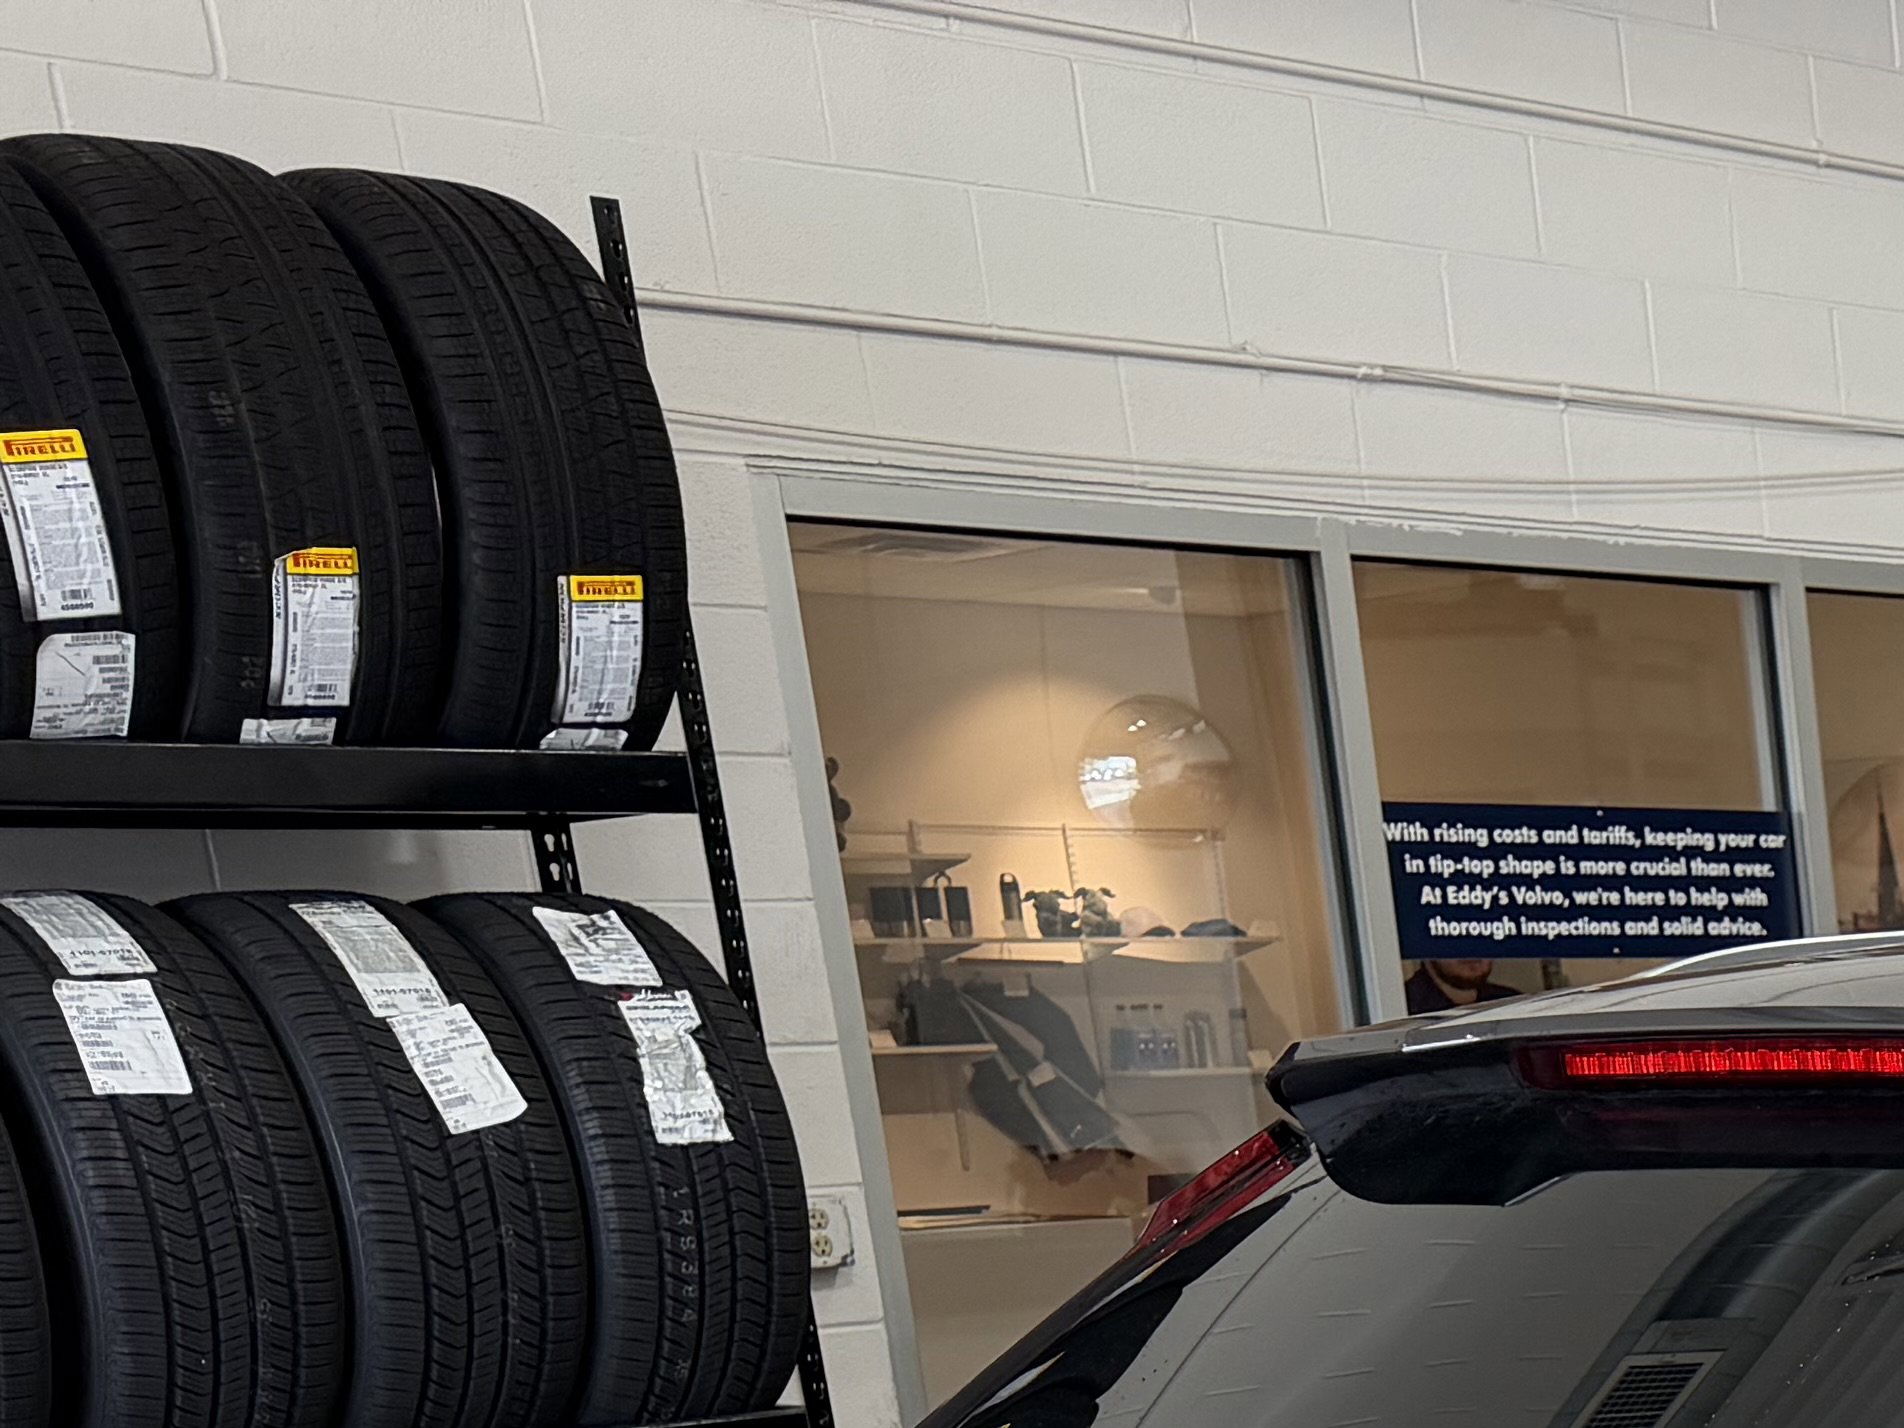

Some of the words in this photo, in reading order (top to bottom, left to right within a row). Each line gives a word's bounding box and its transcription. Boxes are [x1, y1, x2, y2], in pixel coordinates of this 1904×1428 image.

[2, 436, 77, 456] PIRELLI
[577, 581, 636, 595] PIRELLI
[1383, 821, 1430, 842] With
[1434, 822, 1489, 847] rising
[1493, 826, 1539, 844] costs
[1542, 824, 1579, 844] and
[1582, 825, 1642, 848] tariffs,
[1644, 826, 1715, 851] keeping
[1718, 833, 1756, 851] your
[1759, 833, 1786, 848] car
[1404, 853, 1425, 873] in
[1429, 853, 1495, 878] tip-top
[1498, 854, 1556, 879] shape
[1559, 855, 1576, 874] is
[1579, 859, 1626, 875] more
[1630, 856, 1688, 876] crucial
[1690, 856, 1730, 876] than
[1733, 863, 1775, 877] ever.
[1420, 885, 1443, 905] At
[1447, 884, 1509, 909] Eddy's
[1511, 884, 1570, 908] Volvo,
[1572, 887, 1621, 905] we're
[1624, 886, 1665, 906] here
[1668, 888, 1687, 906] to
[1689, 886, 1729, 910] help
[1731, 887, 1768, 906] with
[1429, 915, 1517, 940] thorough
[1520, 916, 1621, 940] inspections
[1624, 916, 1659, 935] and
[1662, 916, 1704, 935] solid
[1707, 916, 1768, 935] advice.
